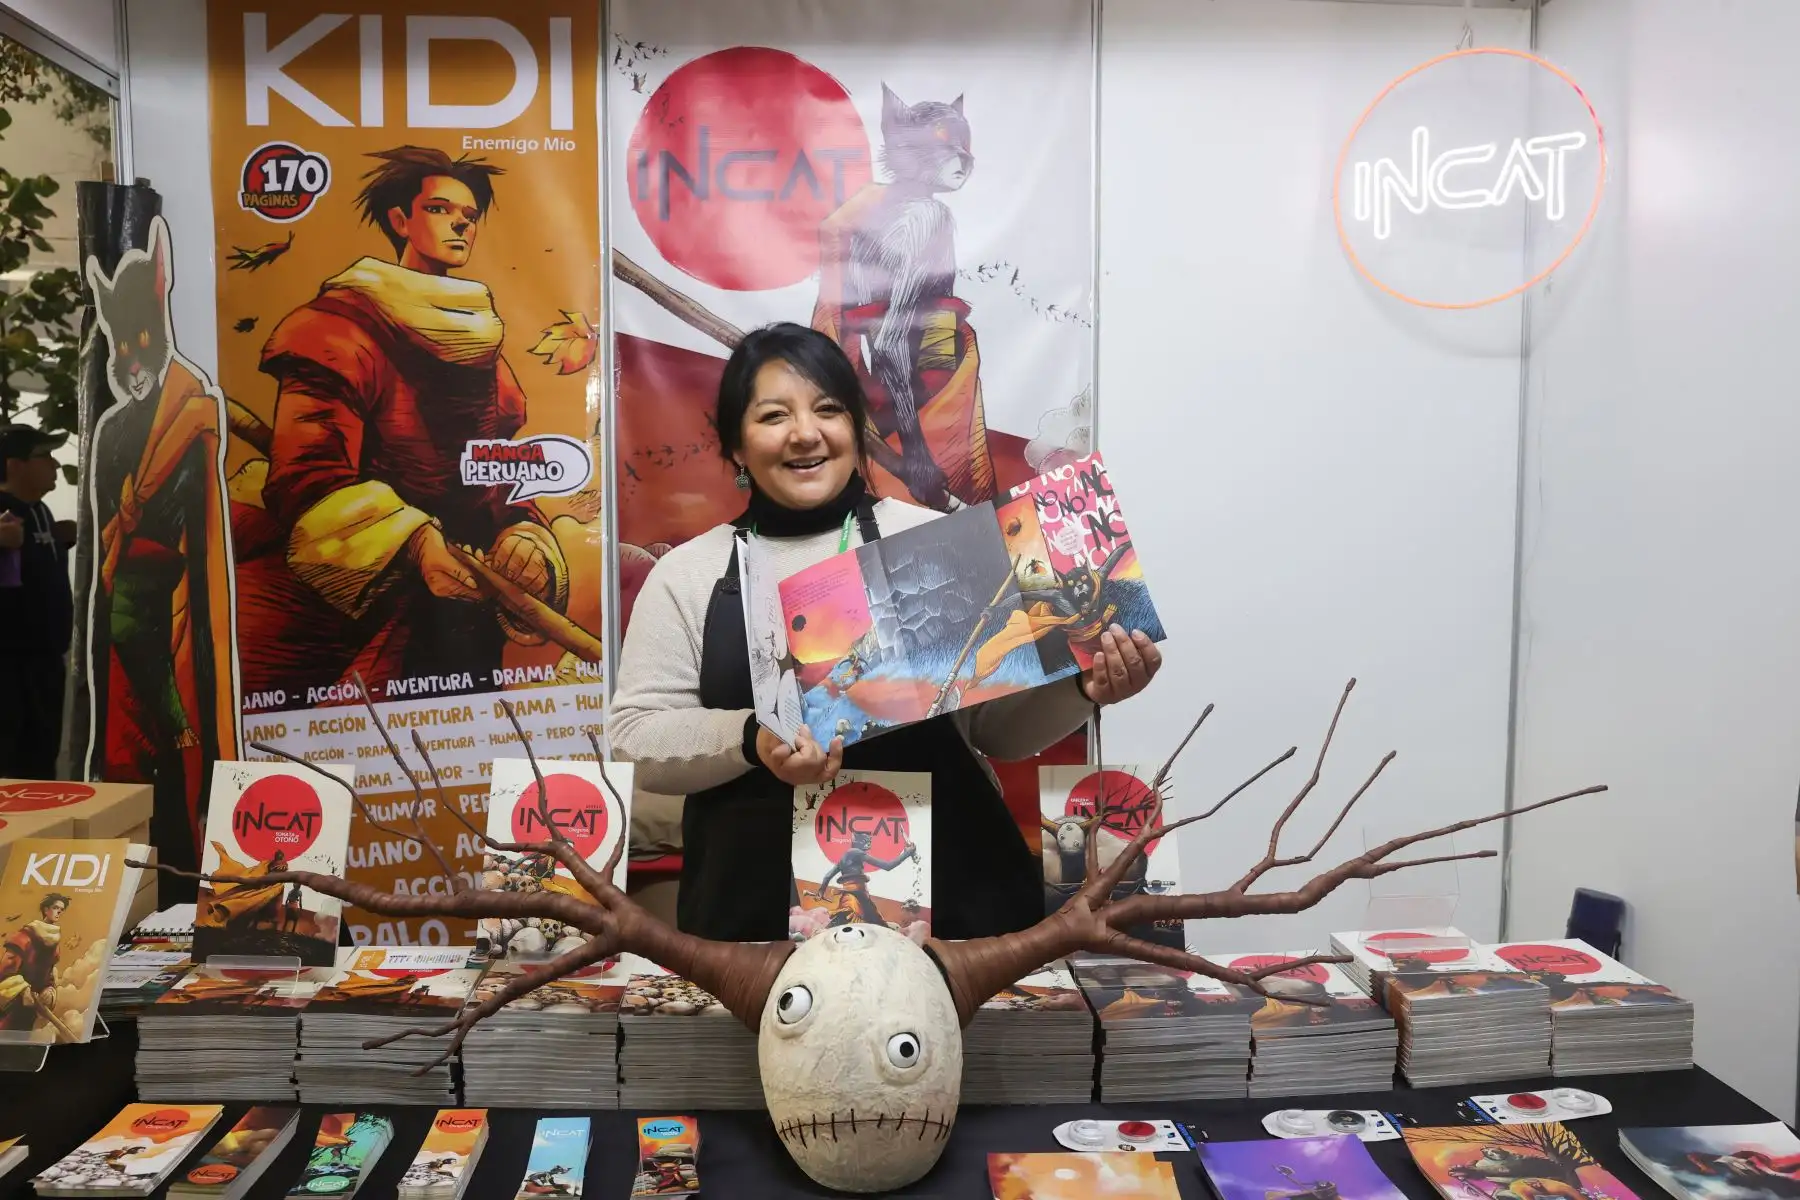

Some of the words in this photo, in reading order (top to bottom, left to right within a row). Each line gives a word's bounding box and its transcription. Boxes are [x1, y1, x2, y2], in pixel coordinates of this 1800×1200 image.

[243, 12, 574, 130] KIDI
[462, 136, 539, 154] Enemigo
[261, 159, 324, 192] 170
[637, 125, 866, 222] INCAT
[1354, 126, 1586, 239] INCAT
[472, 444, 546, 461] MANGA
[465, 460, 564, 481] PERUANO
[1059, 491, 1086, 517] NO
[386, 672, 473, 697] AVENTURA
[492, 664, 557, 686] DRAMA
[387, 706, 474, 730] AVENTURA
[546, 726, 575, 739] PERO
[235, 802, 320, 839] INCAT
[818, 806, 907, 844] INCAT
[345, 839, 422, 868] UANO
[21, 853, 111, 886] KIDI
[132, 1116, 188, 1128] INCAT
[436, 1116, 483, 1127] INCAT
[643, 1125, 683, 1134] INCAT
